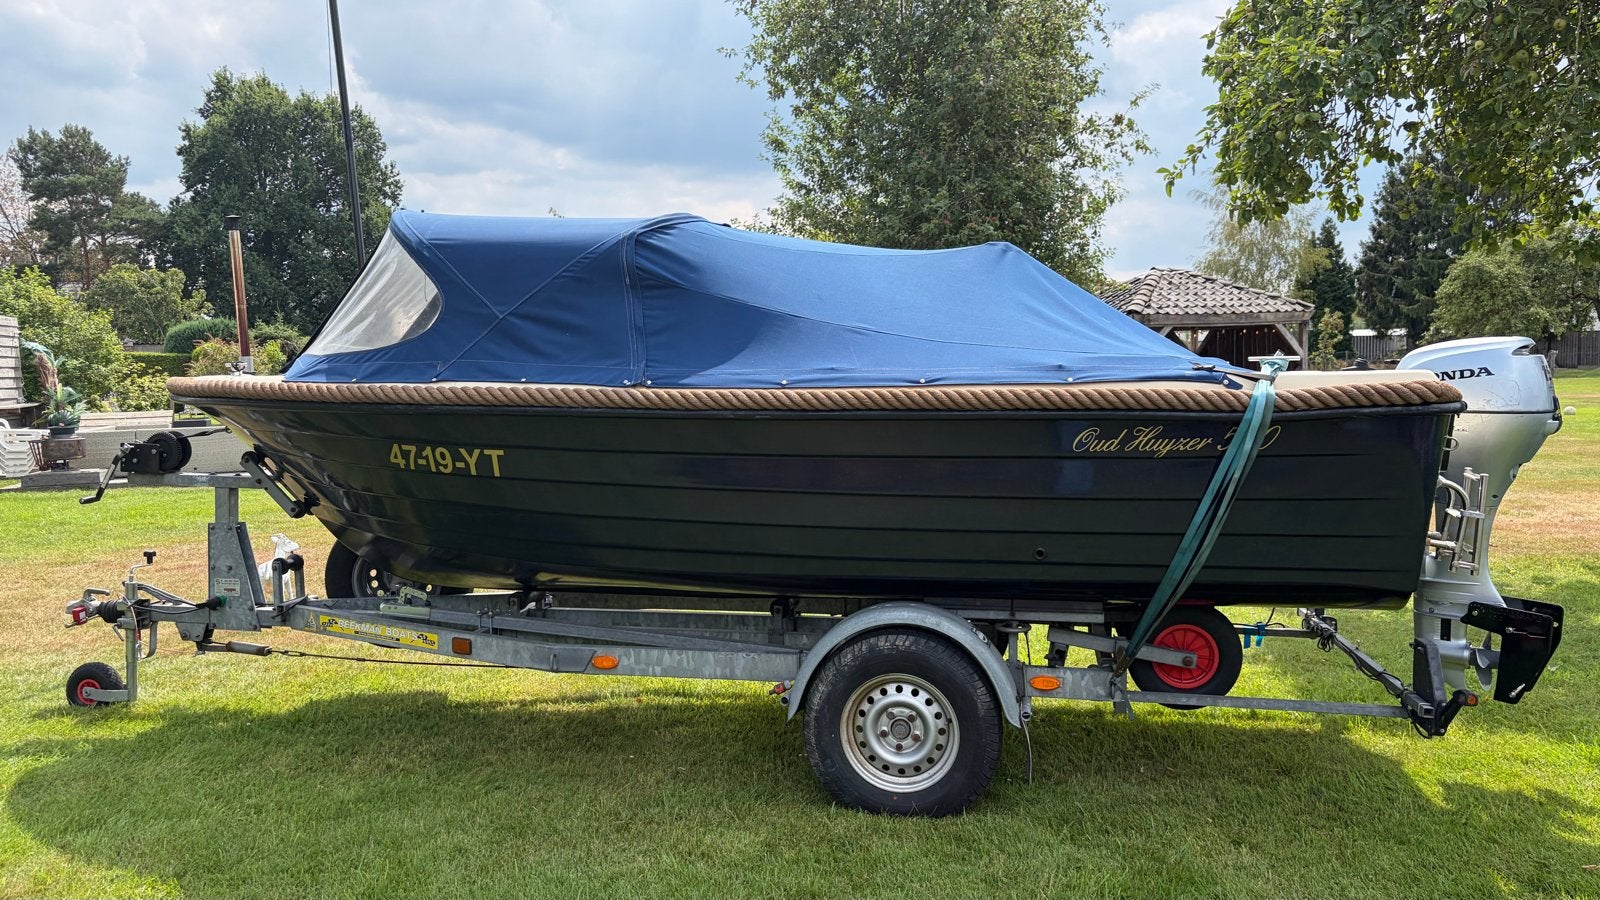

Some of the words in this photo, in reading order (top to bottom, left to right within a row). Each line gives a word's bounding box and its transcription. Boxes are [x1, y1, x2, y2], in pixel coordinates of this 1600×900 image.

[1072, 427, 1128, 452] Oud
[1125, 425, 1213, 458] Huyzer
[1217, 425, 1282, 451] 50
[389, 443, 505, 478] 47-19-YT
[338, 619, 383, 635] BEEKMAN
[385, 627, 419, 641] BOATS
